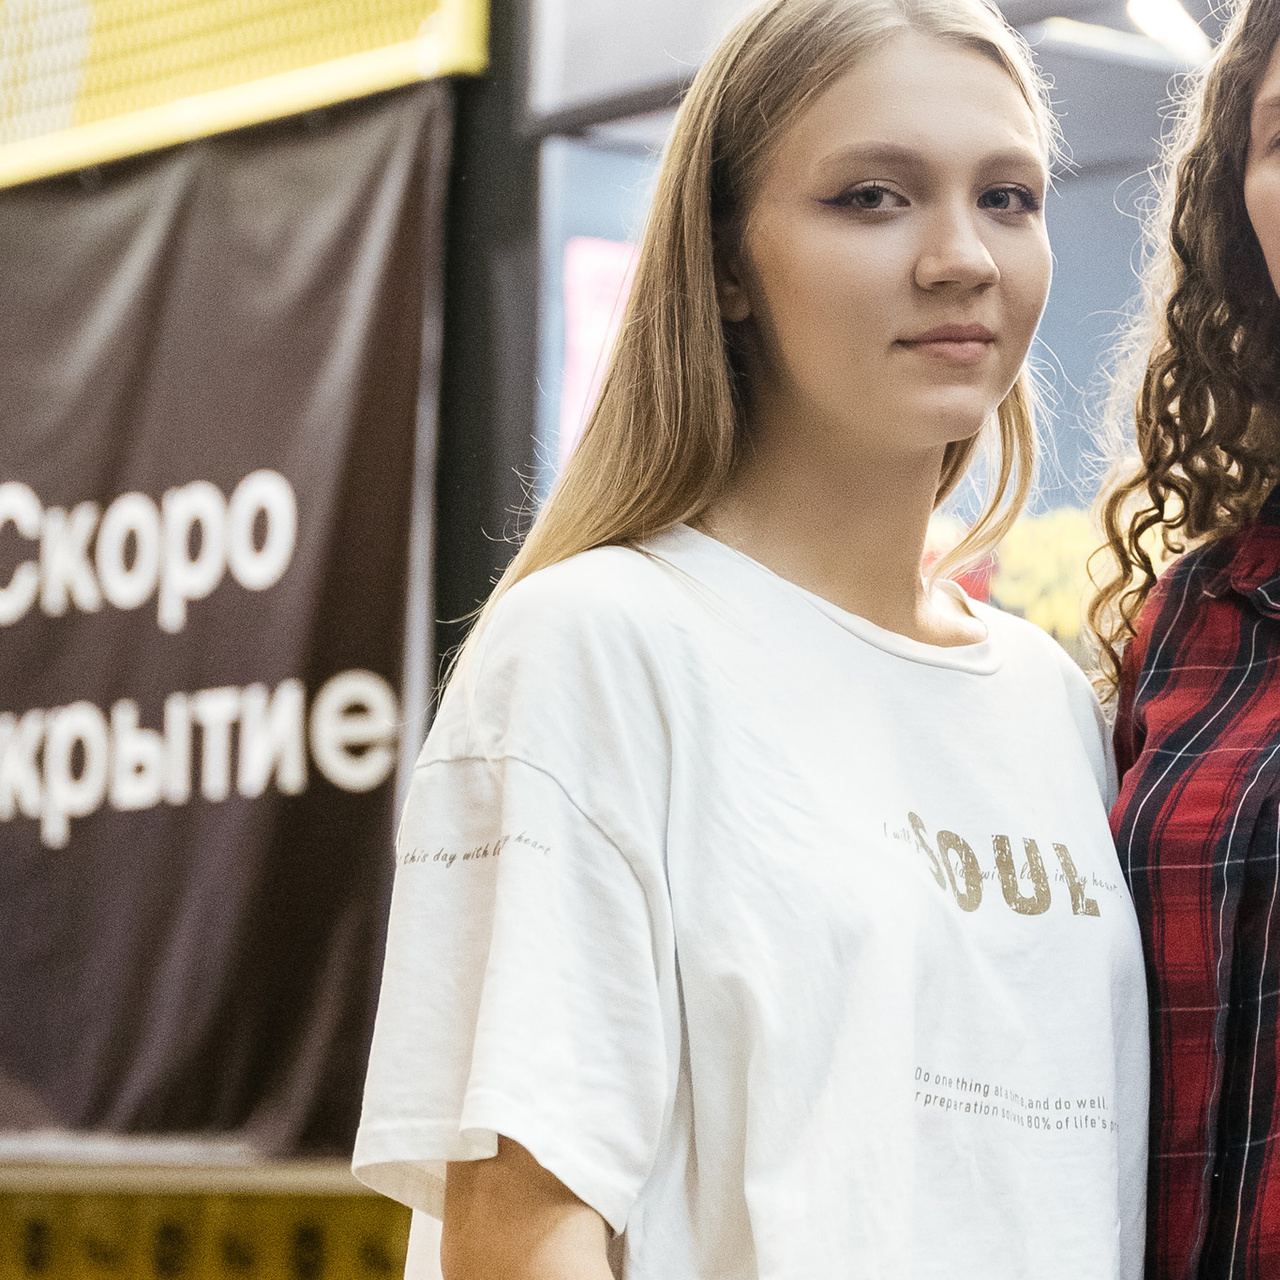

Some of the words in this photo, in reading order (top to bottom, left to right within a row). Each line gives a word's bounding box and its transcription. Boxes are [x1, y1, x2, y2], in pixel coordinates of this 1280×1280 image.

[907, 811, 1101, 917] SOUL
[914, 1066, 931, 1083] Do
[956, 1077, 990, 1099] thing
[1026, 1115, 1052, 1131] 80%
[1055, 1116, 1070, 1131] of
